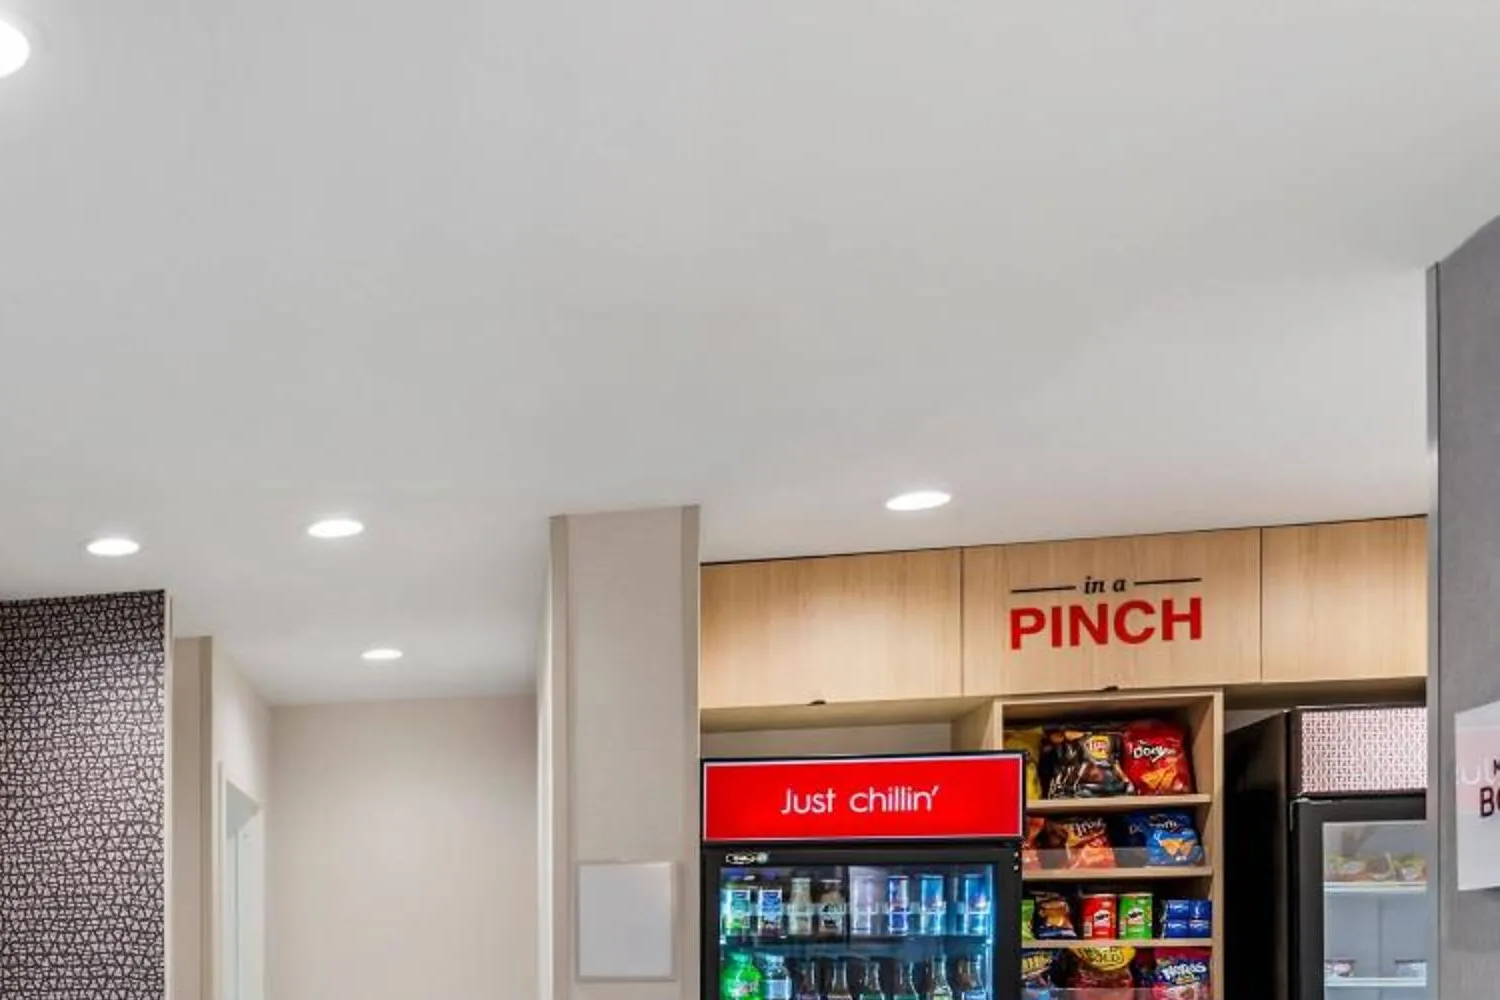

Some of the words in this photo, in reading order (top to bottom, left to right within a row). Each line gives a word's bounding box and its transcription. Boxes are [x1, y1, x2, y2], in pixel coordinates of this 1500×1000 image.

[1084, 576, 1105, 594] in
[1113, 578, 1127, 593] a
[1010, 597, 1202, 650] PINCH
[780, 787, 836, 815] Just
